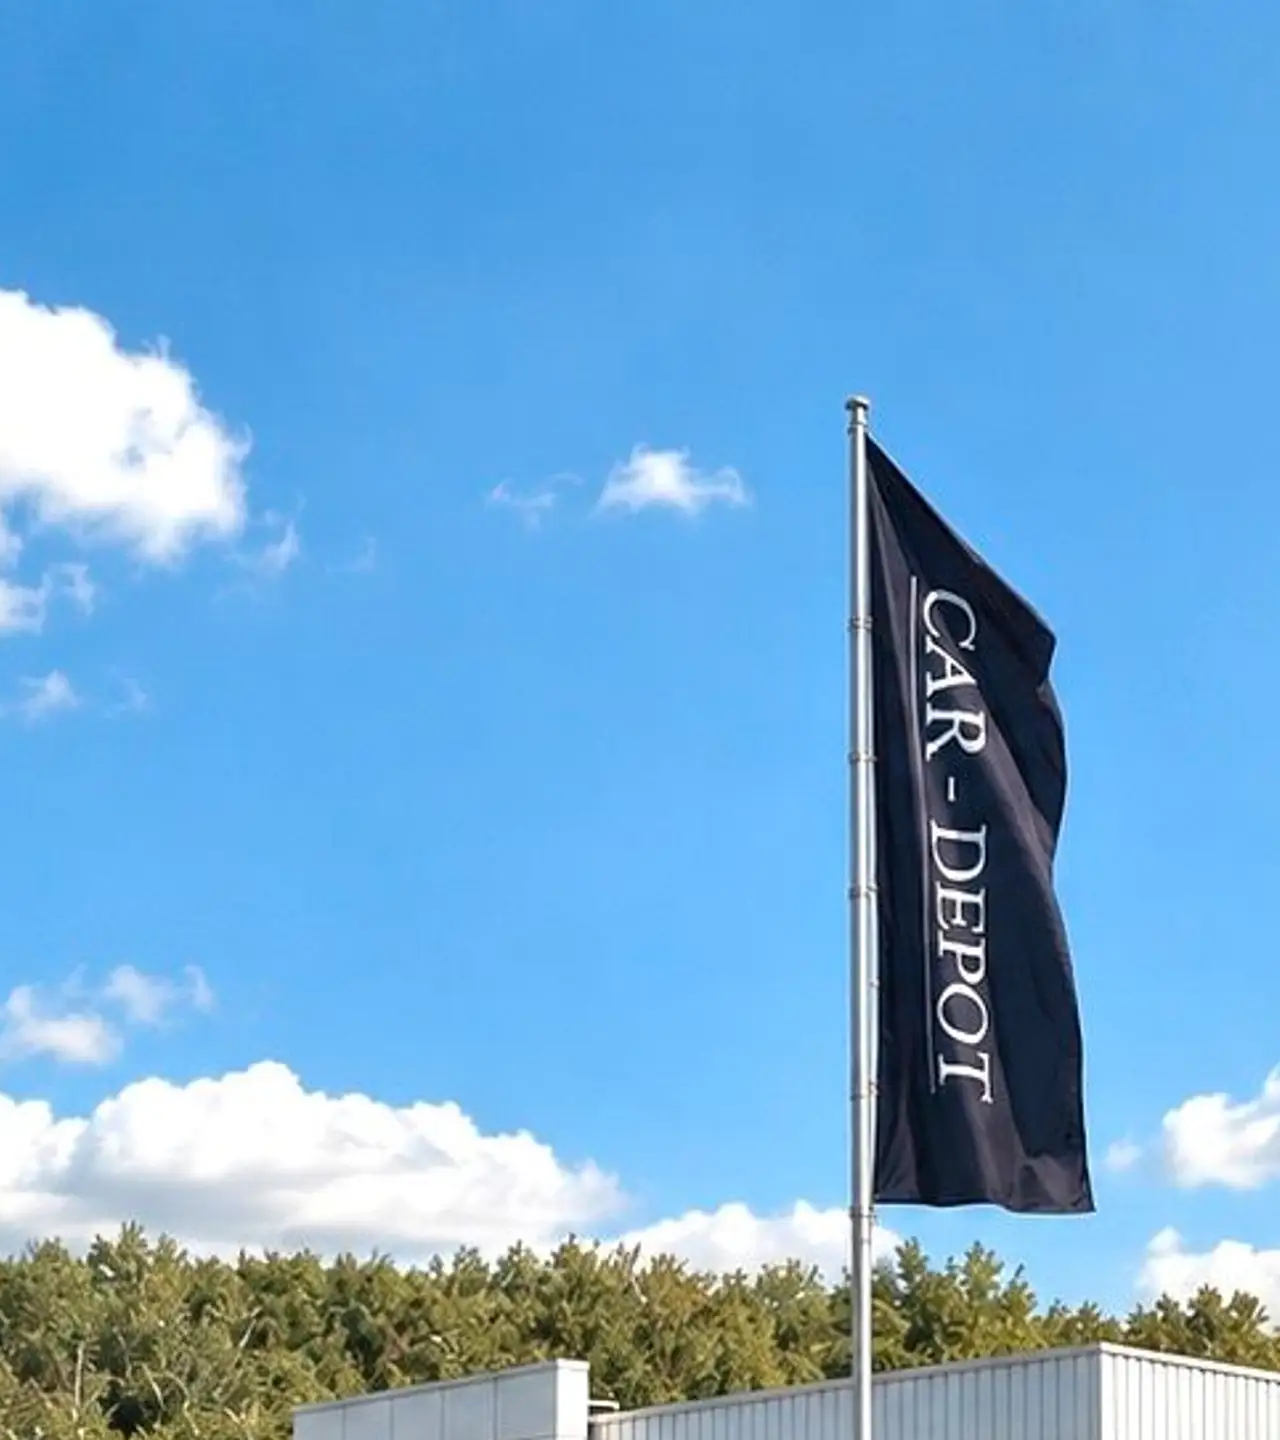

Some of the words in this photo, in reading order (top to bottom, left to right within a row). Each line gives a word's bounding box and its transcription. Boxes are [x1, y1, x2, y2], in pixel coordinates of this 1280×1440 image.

[923, 587, 988, 763] CAR
[946, 774, 958, 802] -
[928, 819, 995, 1103] DEPOT
